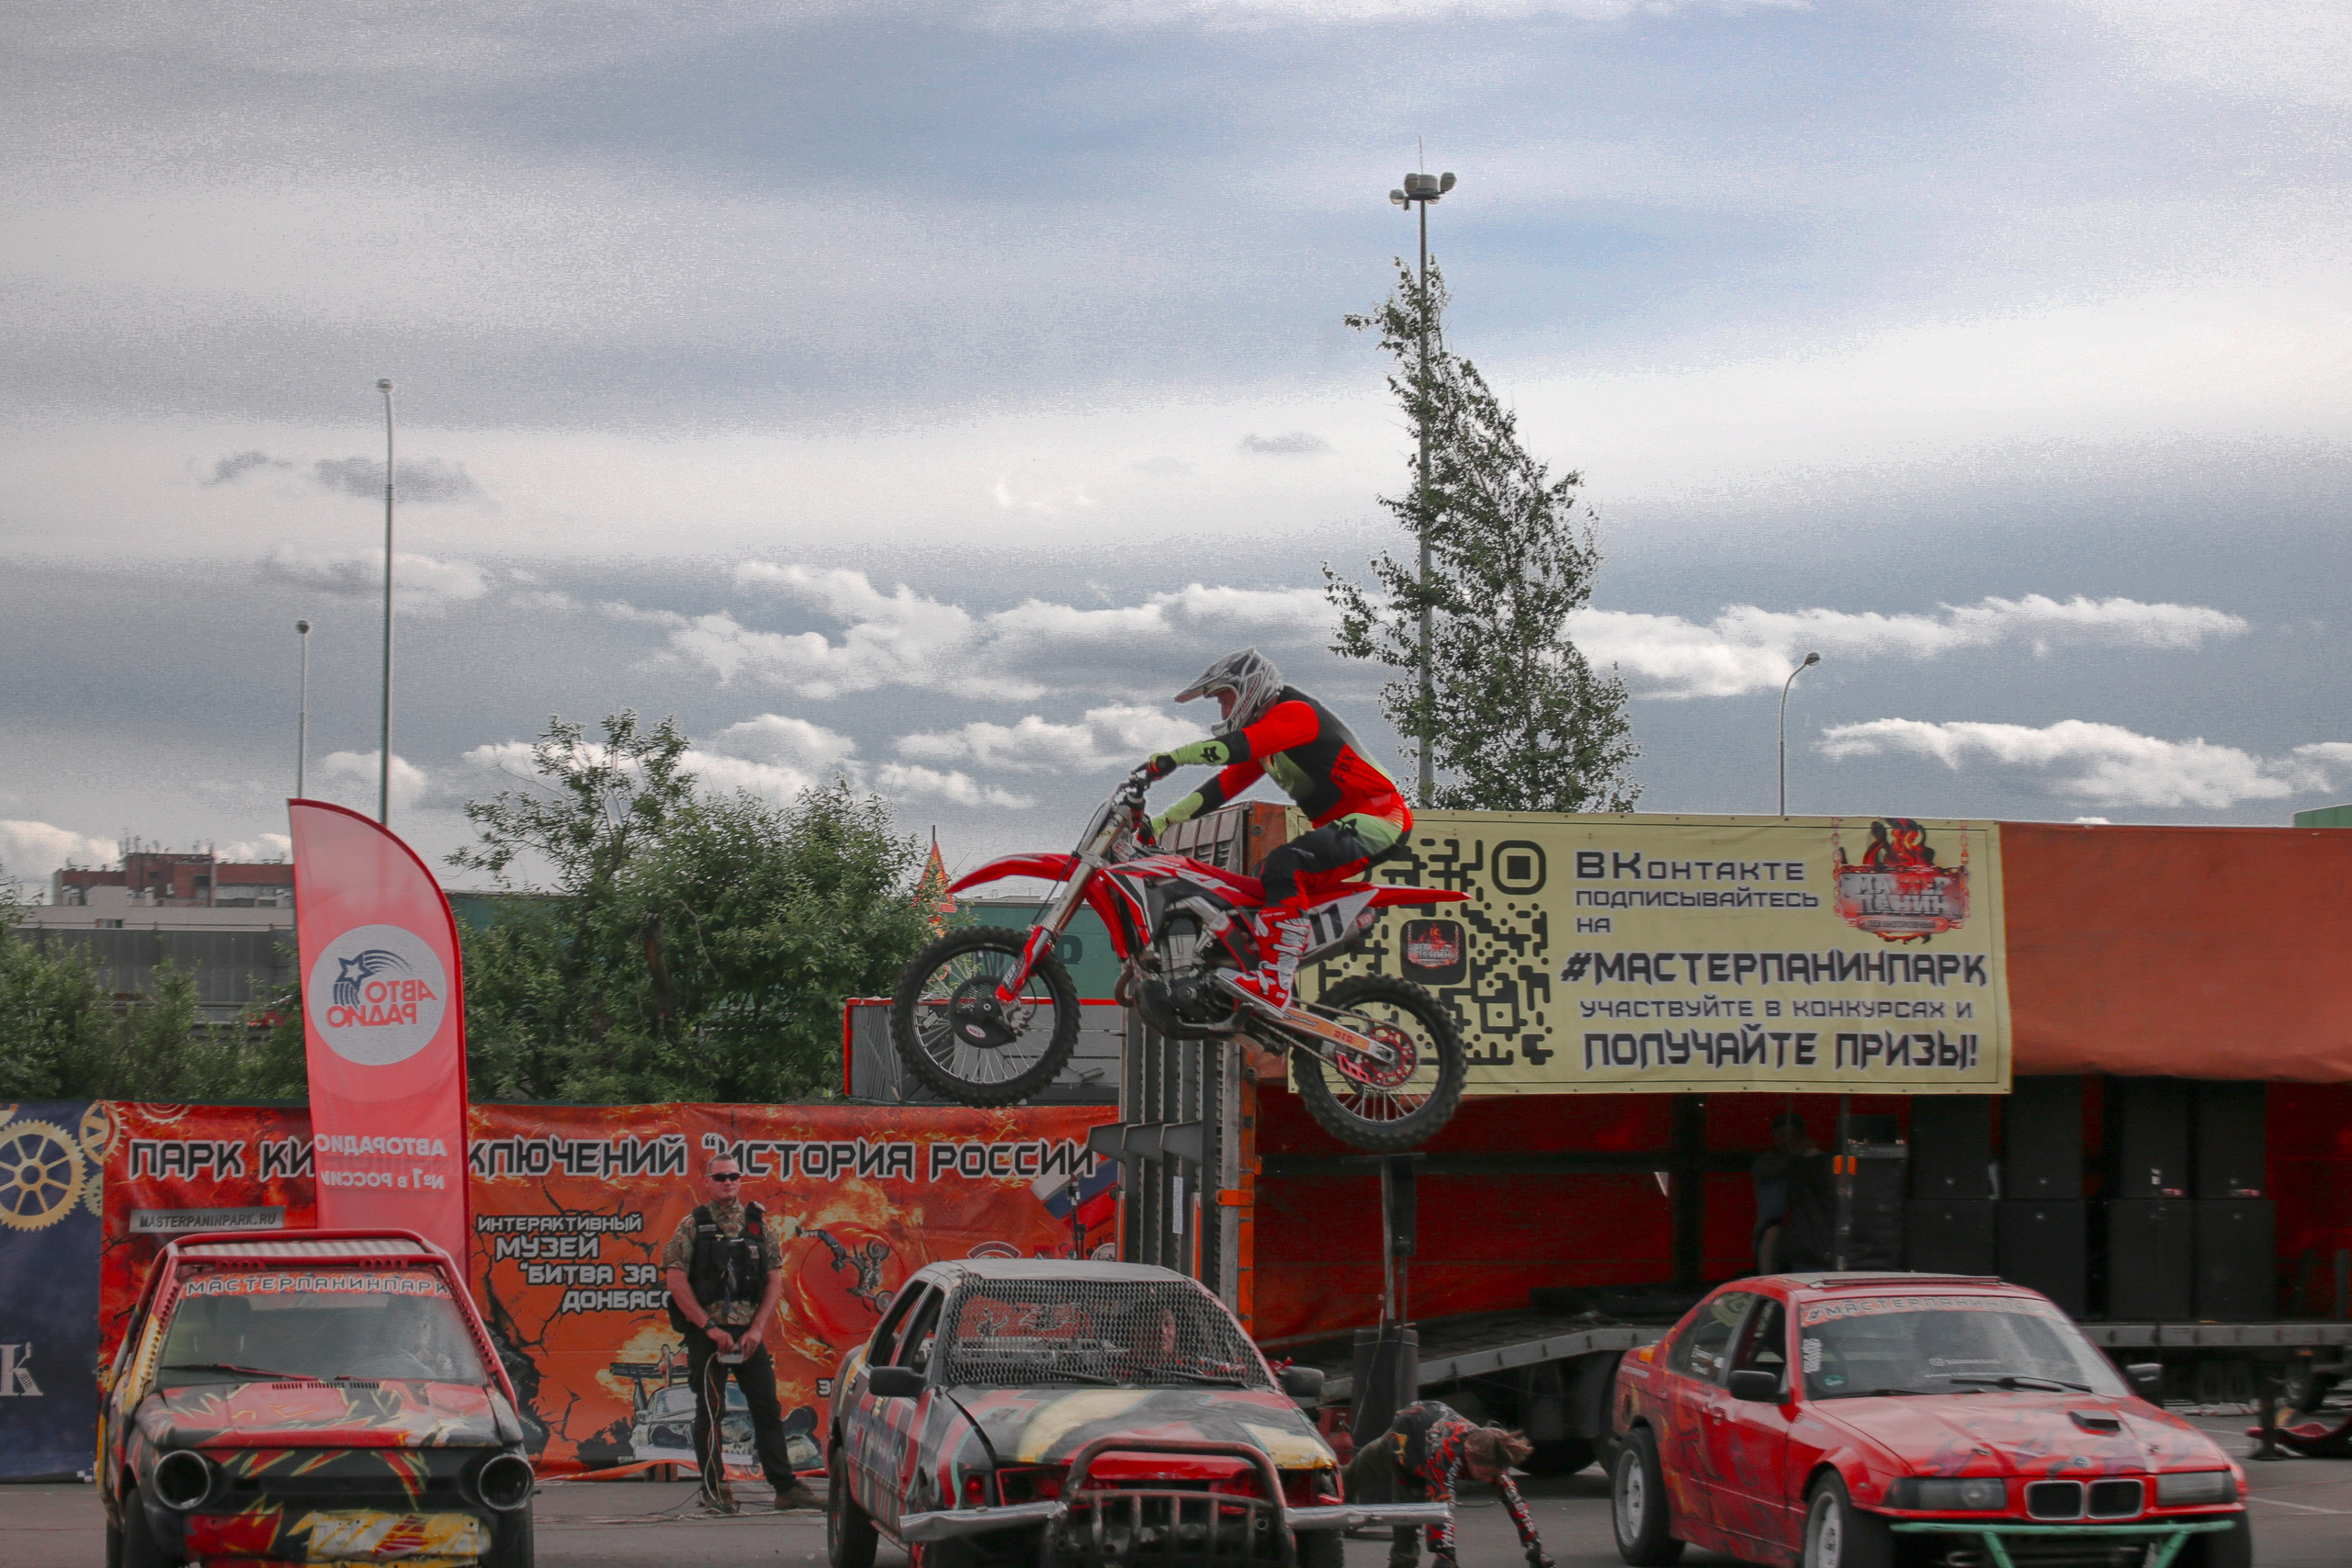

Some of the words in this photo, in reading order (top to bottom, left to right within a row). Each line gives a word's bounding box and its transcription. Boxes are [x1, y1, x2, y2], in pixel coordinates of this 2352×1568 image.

[1334, 753, 1355, 784] FOX
[1575, 886, 1819, 908] ПОДПИСЫВАЙТЕСЬ
[1576, 917, 1611, 933] НА
[1560, 948, 1987, 987] #МАСТЕРПАНИНПАРК
[1579, 995, 1754, 1018] УЧАСТВУЙТЕ
[1765, 999, 1781, 1017] В
[1792, 1000, 1944, 1019] КОНКУРСАХ
[1956, 1001, 1973, 1019] И
[1583, 1022, 1818, 1071] ПОЛУЧАЙТЕ
[1835, 1030, 1978, 1071] ПРИЗЫ!
[129, 1138, 247, 1182] ПАРК
[139, 1213, 277, 1229] MASTERPANINPARK.RU
[477, 1213, 642, 1233] ИНТЕРАКТИВНЫЙ
[496, 1232, 600, 1260] МУЗЕЙ
[186, 1275, 451, 1296] МАСТЕРПАНИНПАРК
[624, 1265, 658, 1285] ЗА
